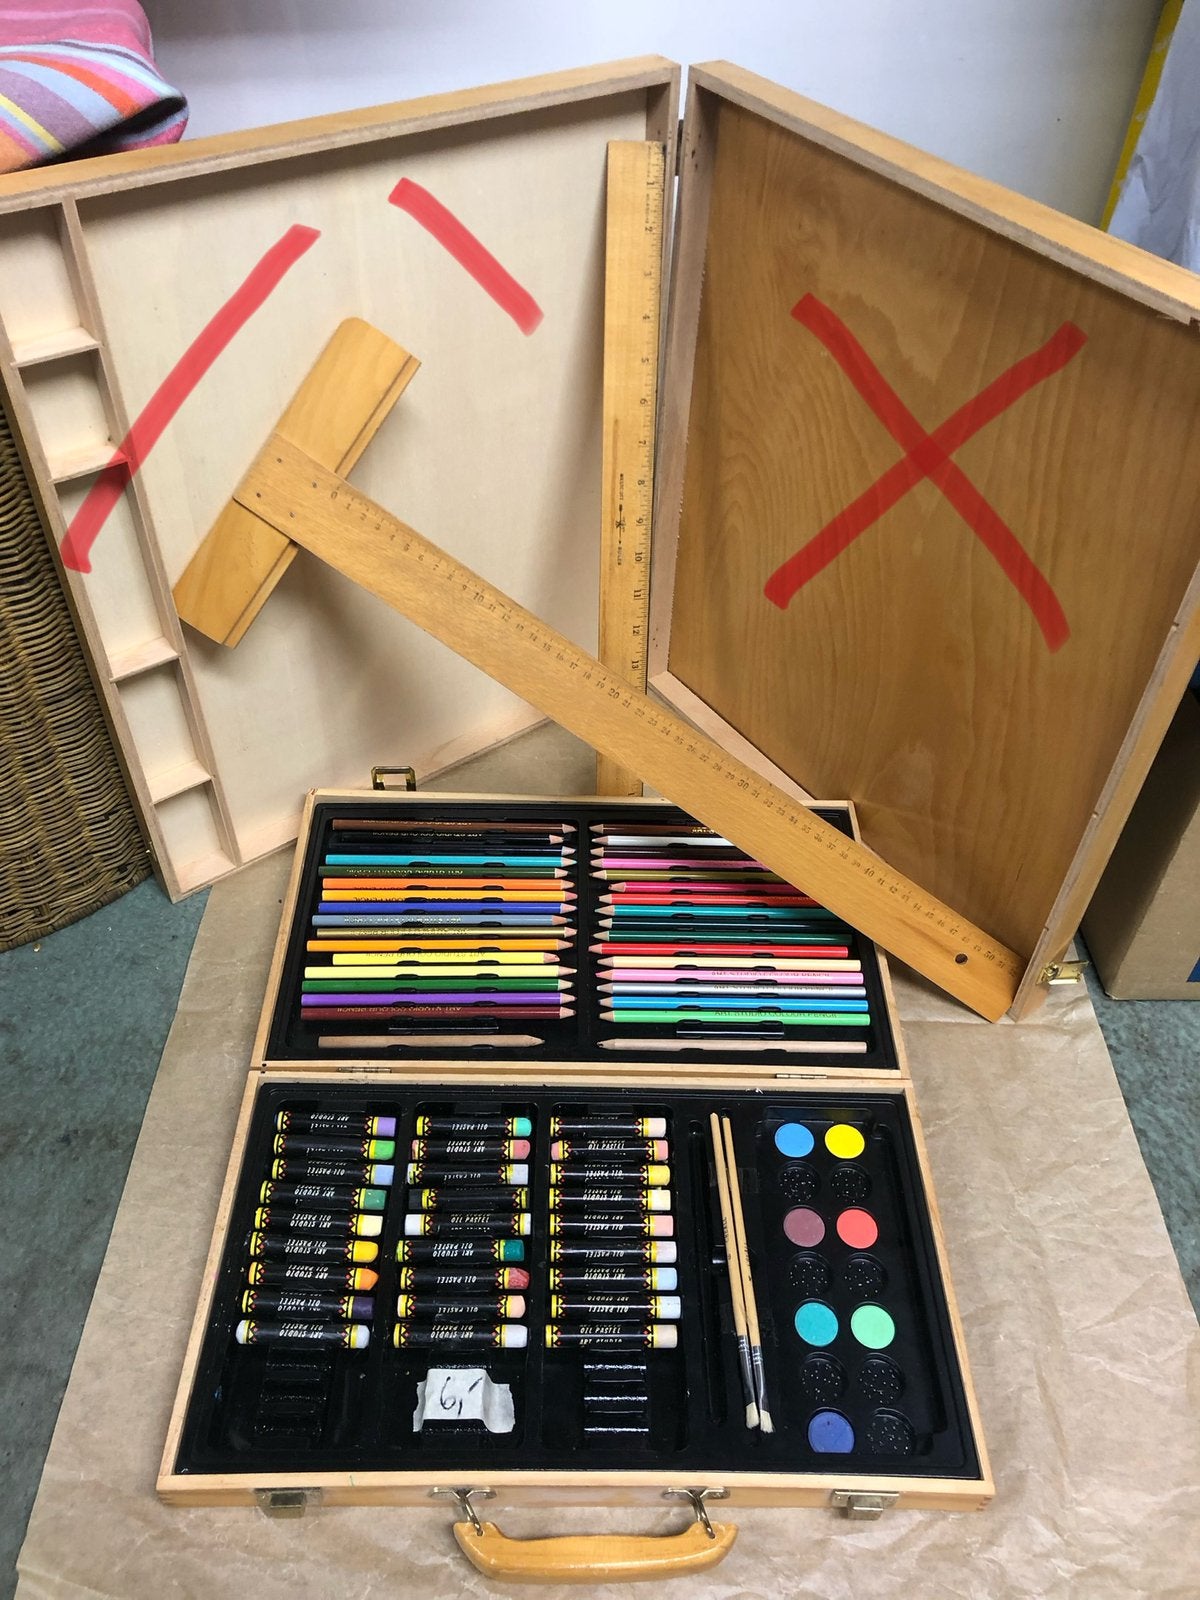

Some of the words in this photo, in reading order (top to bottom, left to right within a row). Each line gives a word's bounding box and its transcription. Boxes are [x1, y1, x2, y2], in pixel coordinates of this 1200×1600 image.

[634, 552, 642, 562] 10
[634, 589, 642, 600] 11
[632, 624, 640, 635] 12
[632, 660, 639, 670] 13
